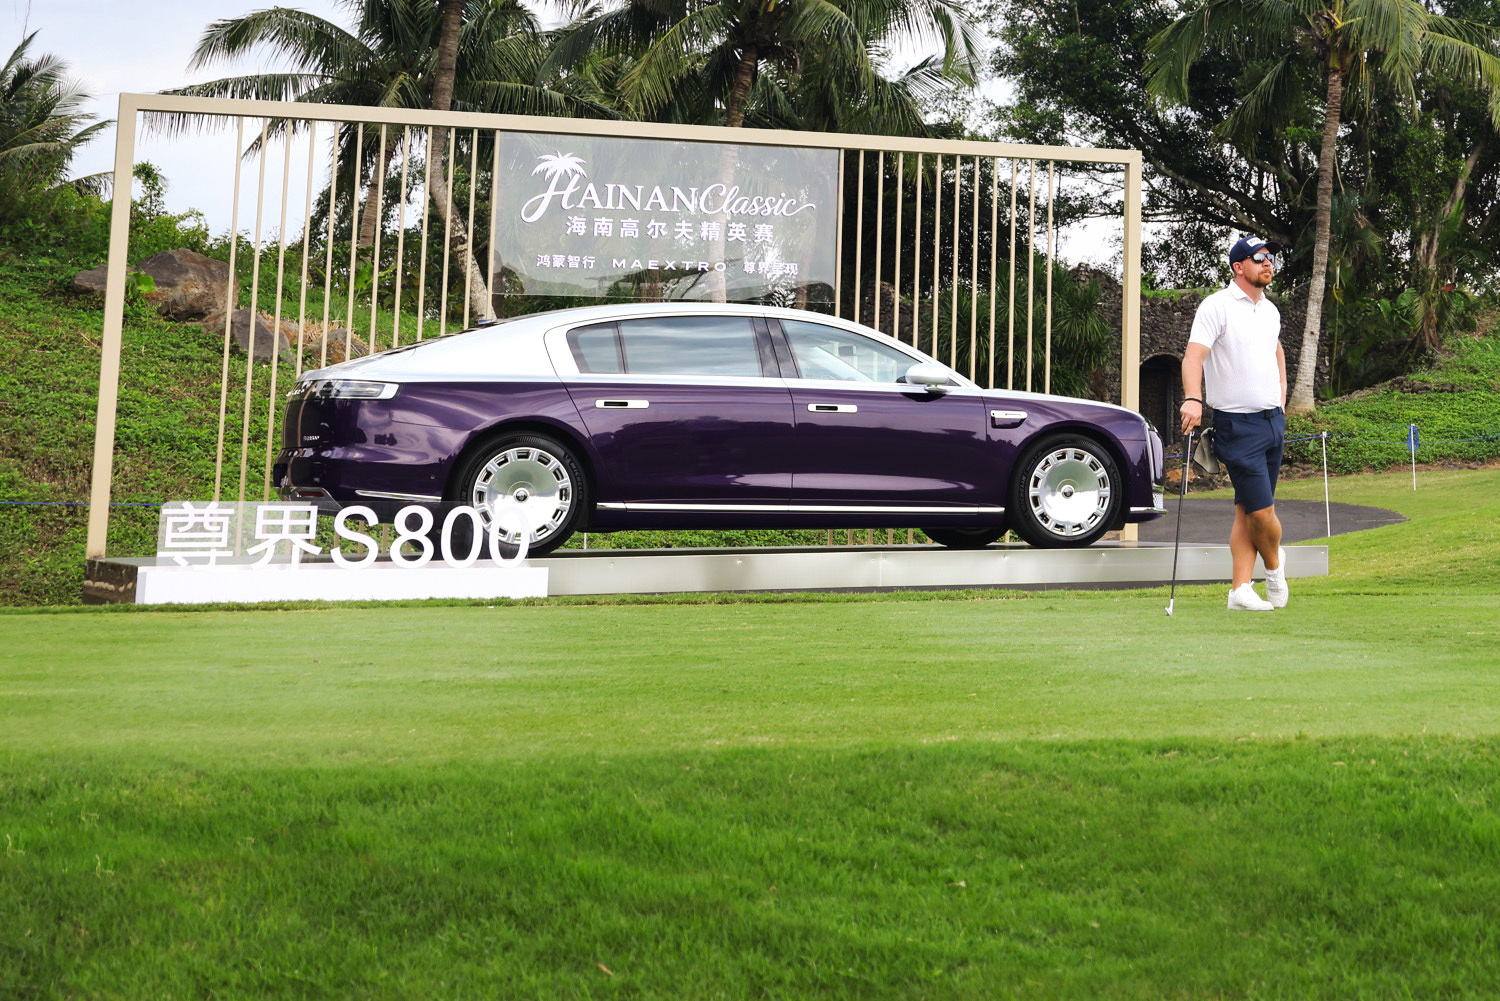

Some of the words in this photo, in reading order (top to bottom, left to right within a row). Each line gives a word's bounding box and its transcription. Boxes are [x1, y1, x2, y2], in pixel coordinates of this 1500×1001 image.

[520, 171, 697, 223] HAINAN
[698, 183, 816, 217] Classic
[565, 215, 774, 243] 海南高尔夫精英赛
[536, 254, 596, 269] 鸿蒙智行
[612, 258, 727, 272] MAEXTRO
[743, 261, 798, 276] 尊界呈现
